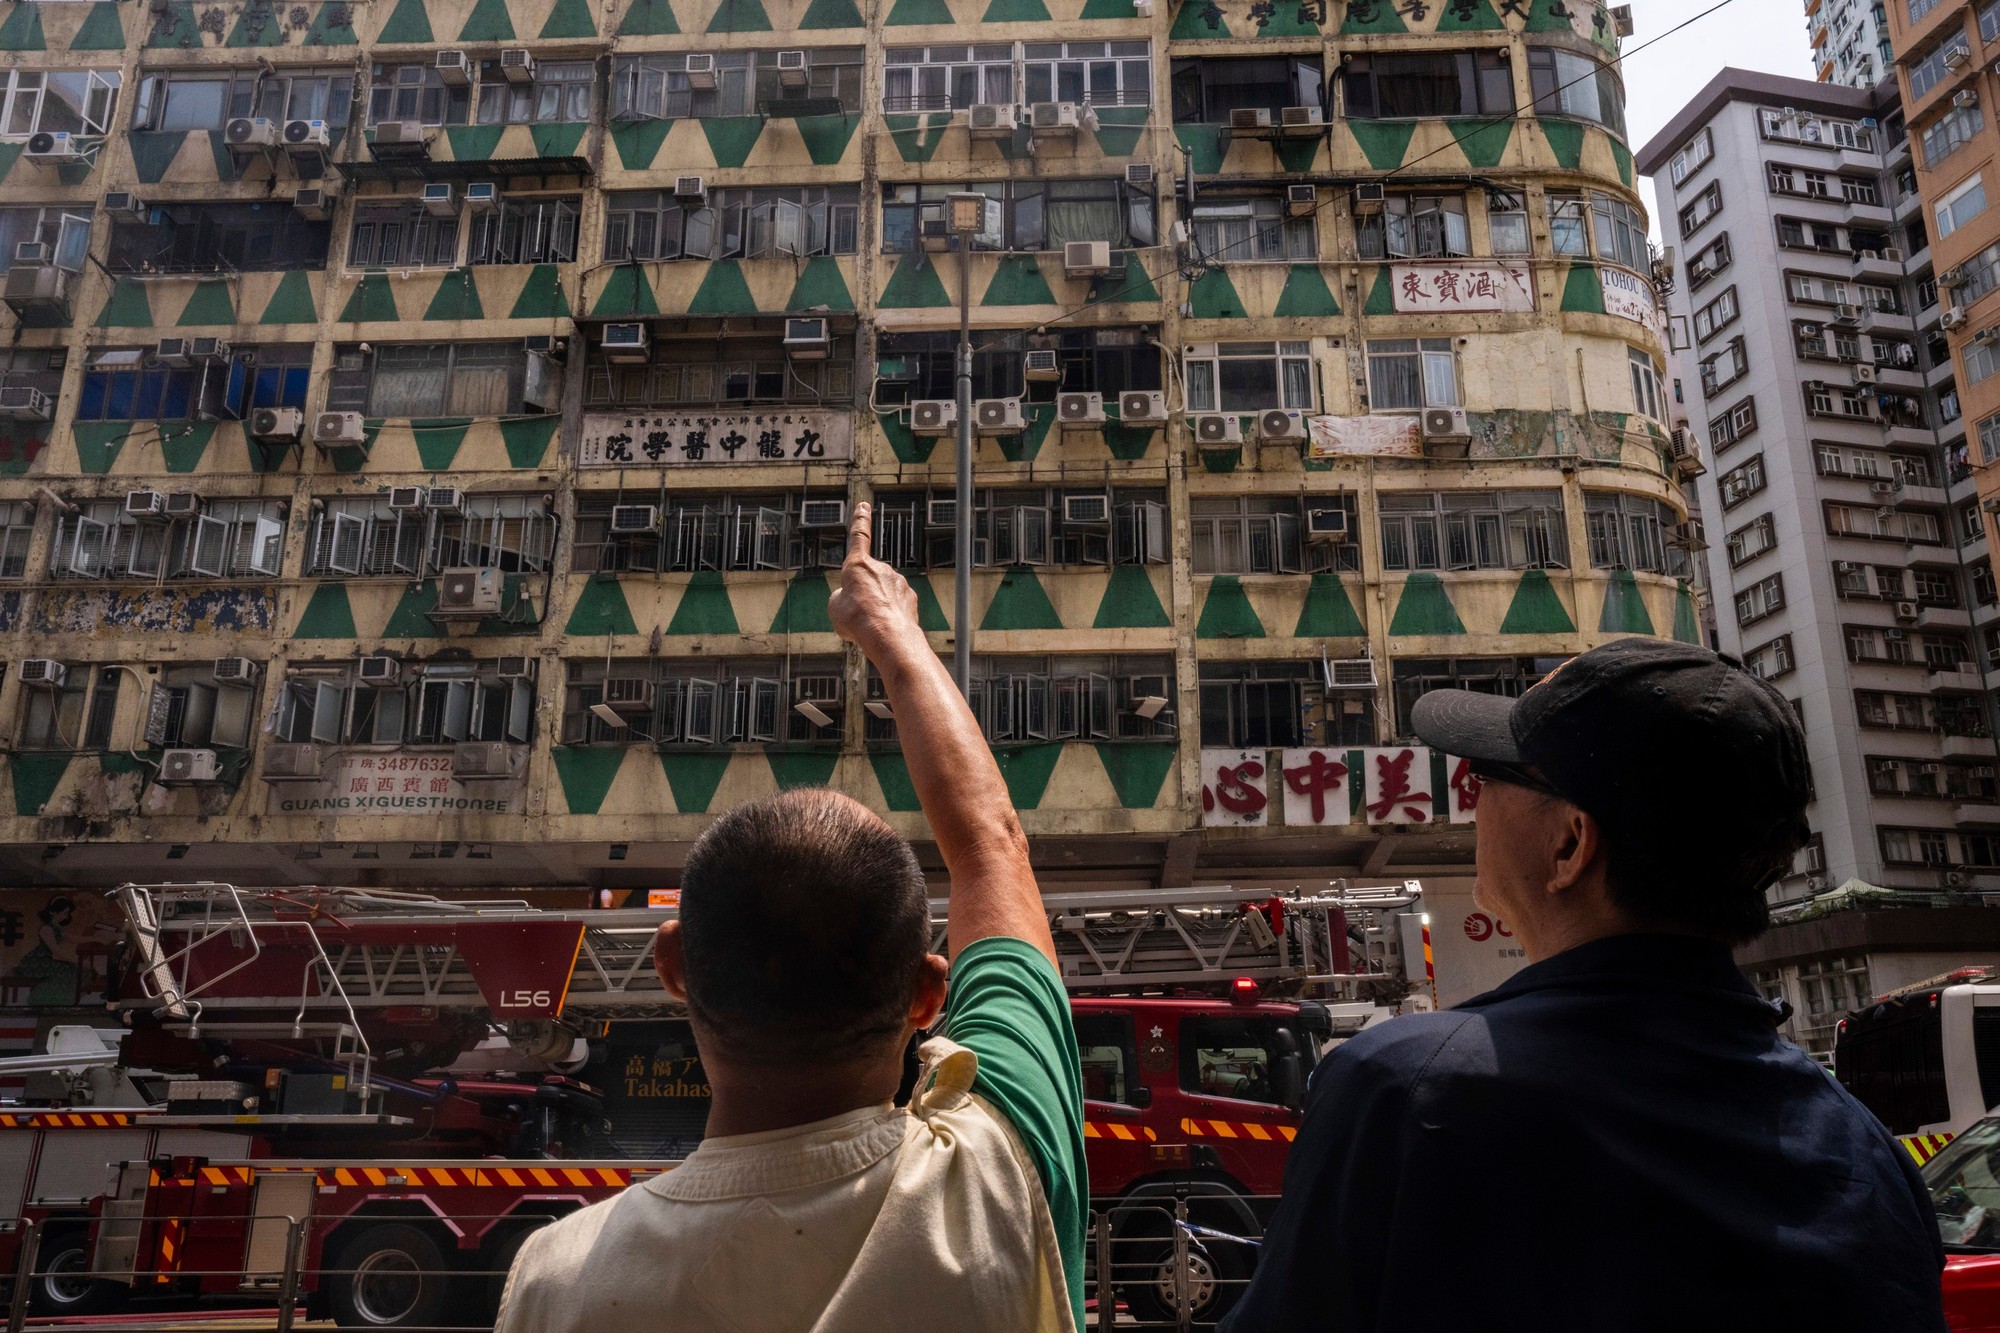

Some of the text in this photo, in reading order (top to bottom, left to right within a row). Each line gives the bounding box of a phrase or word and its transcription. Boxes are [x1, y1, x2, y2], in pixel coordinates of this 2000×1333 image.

[1402, 269, 1527, 303] 東寶酒
[605, 429, 824, 461] 九龍中醫學院
[378, 757, 455, 771] 3487632
[350, 777, 449, 793] 廣西賓館
[281, 797, 350, 811] GUANG
[500, 990, 550, 1007] L56
